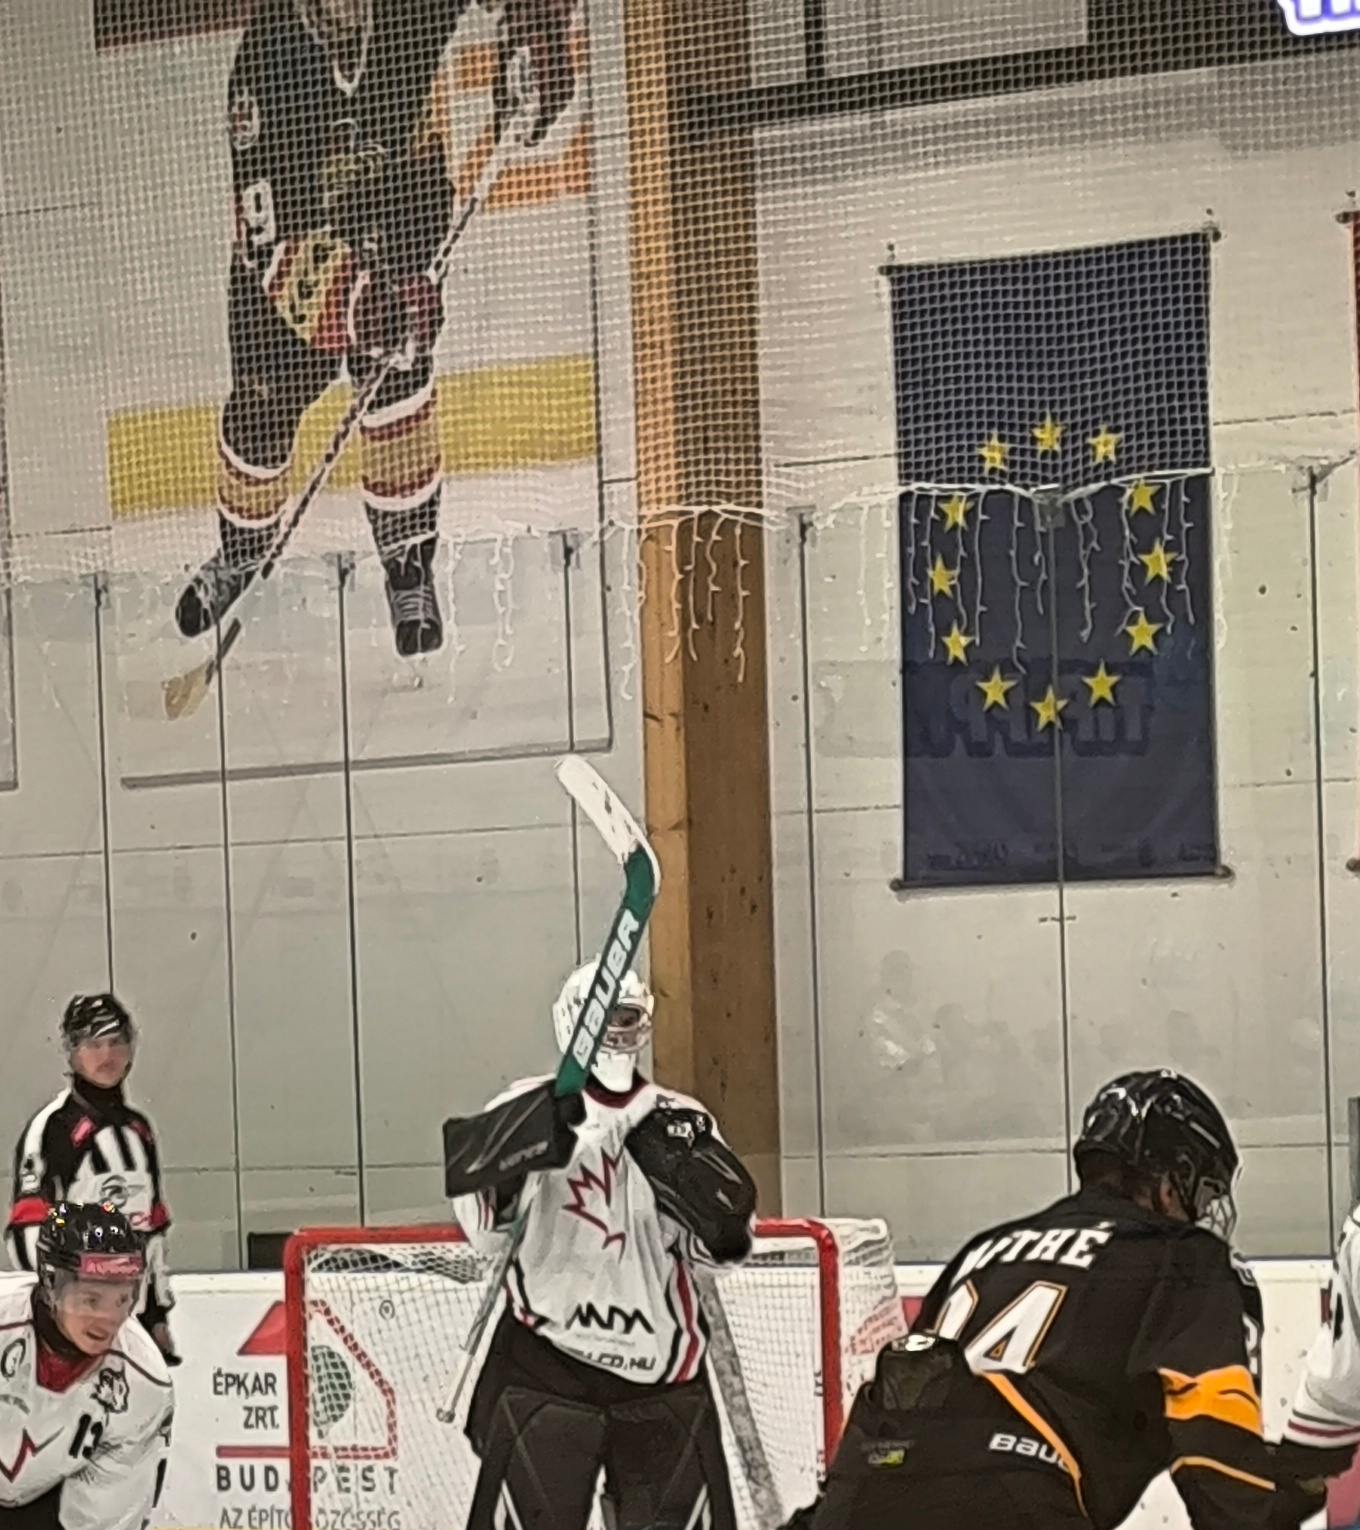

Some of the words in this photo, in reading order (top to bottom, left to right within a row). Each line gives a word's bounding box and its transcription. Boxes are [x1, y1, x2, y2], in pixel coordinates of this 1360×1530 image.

[571, 907, 640, 1071] BAUER
[213, 1367, 278, 1398] ÉPKAR
[243, 1405, 280, 1430] ZRT.
[215, 1463, 400, 1495] BUDPEST
[219, 1507, 243, 1530] AZ
